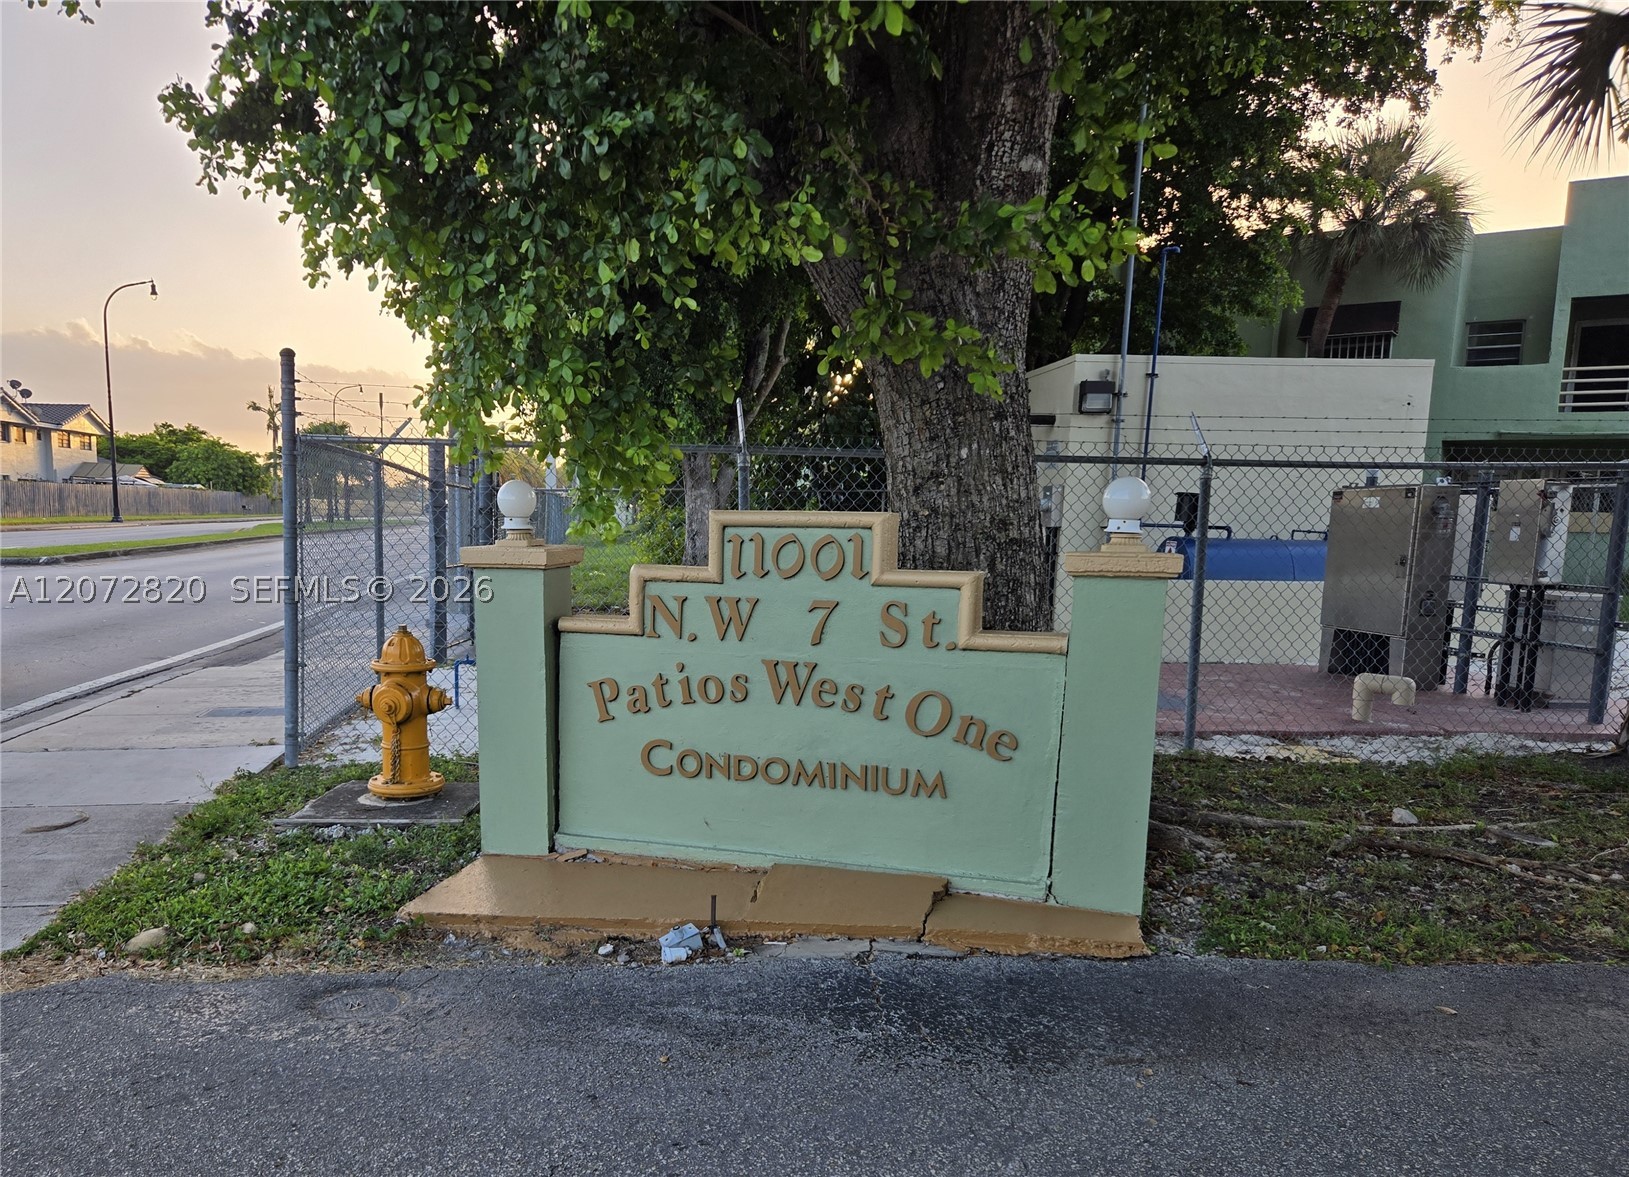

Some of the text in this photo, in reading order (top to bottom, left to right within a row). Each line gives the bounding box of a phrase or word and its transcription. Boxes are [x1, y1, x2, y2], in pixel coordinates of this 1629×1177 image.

[727, 532, 869, 581] 11001
[808, 600, 838, 646] 7
[879, 600, 956, 650] St.
[587, 659, 1018, 762] Patios West One
[640, 738, 947, 799] CONDOMINIUM
